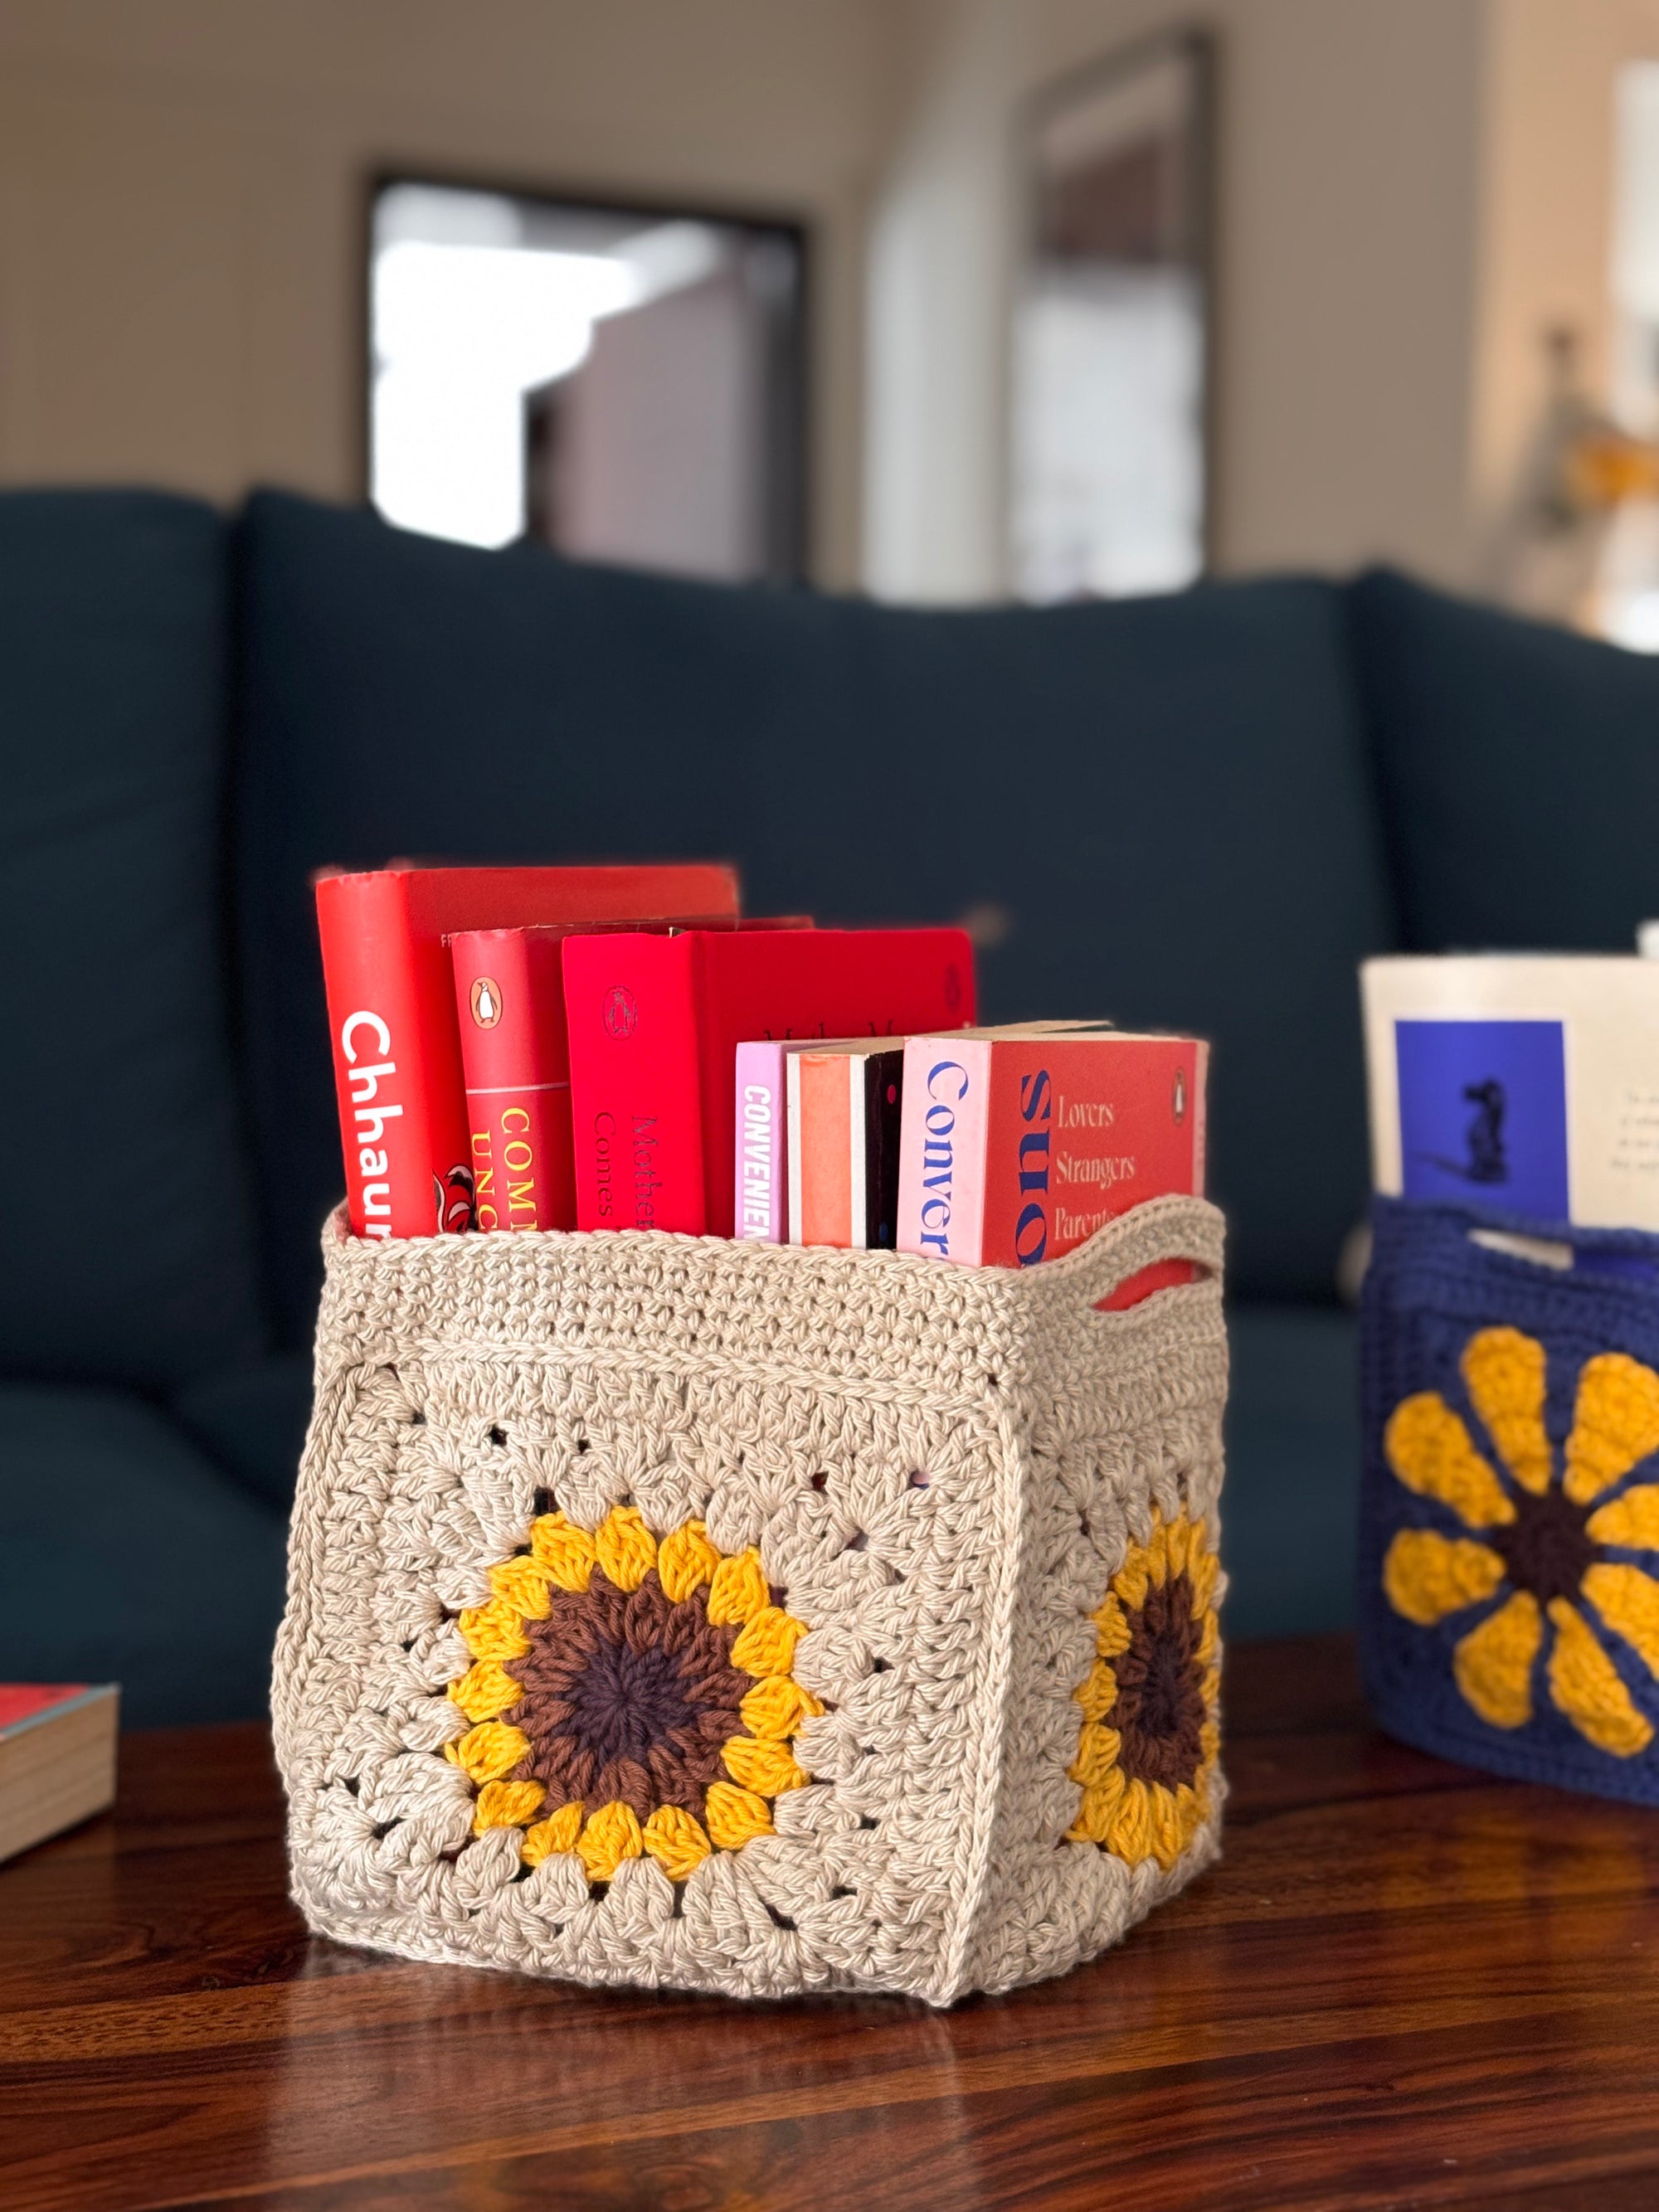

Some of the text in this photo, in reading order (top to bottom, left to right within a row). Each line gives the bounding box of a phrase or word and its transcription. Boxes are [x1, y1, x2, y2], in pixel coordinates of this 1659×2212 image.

[1058, 1095, 1115, 1127] Lovers
[594, 1111, 614, 1217] Comes
[1056, 1150, 1136, 1189] Strangers
